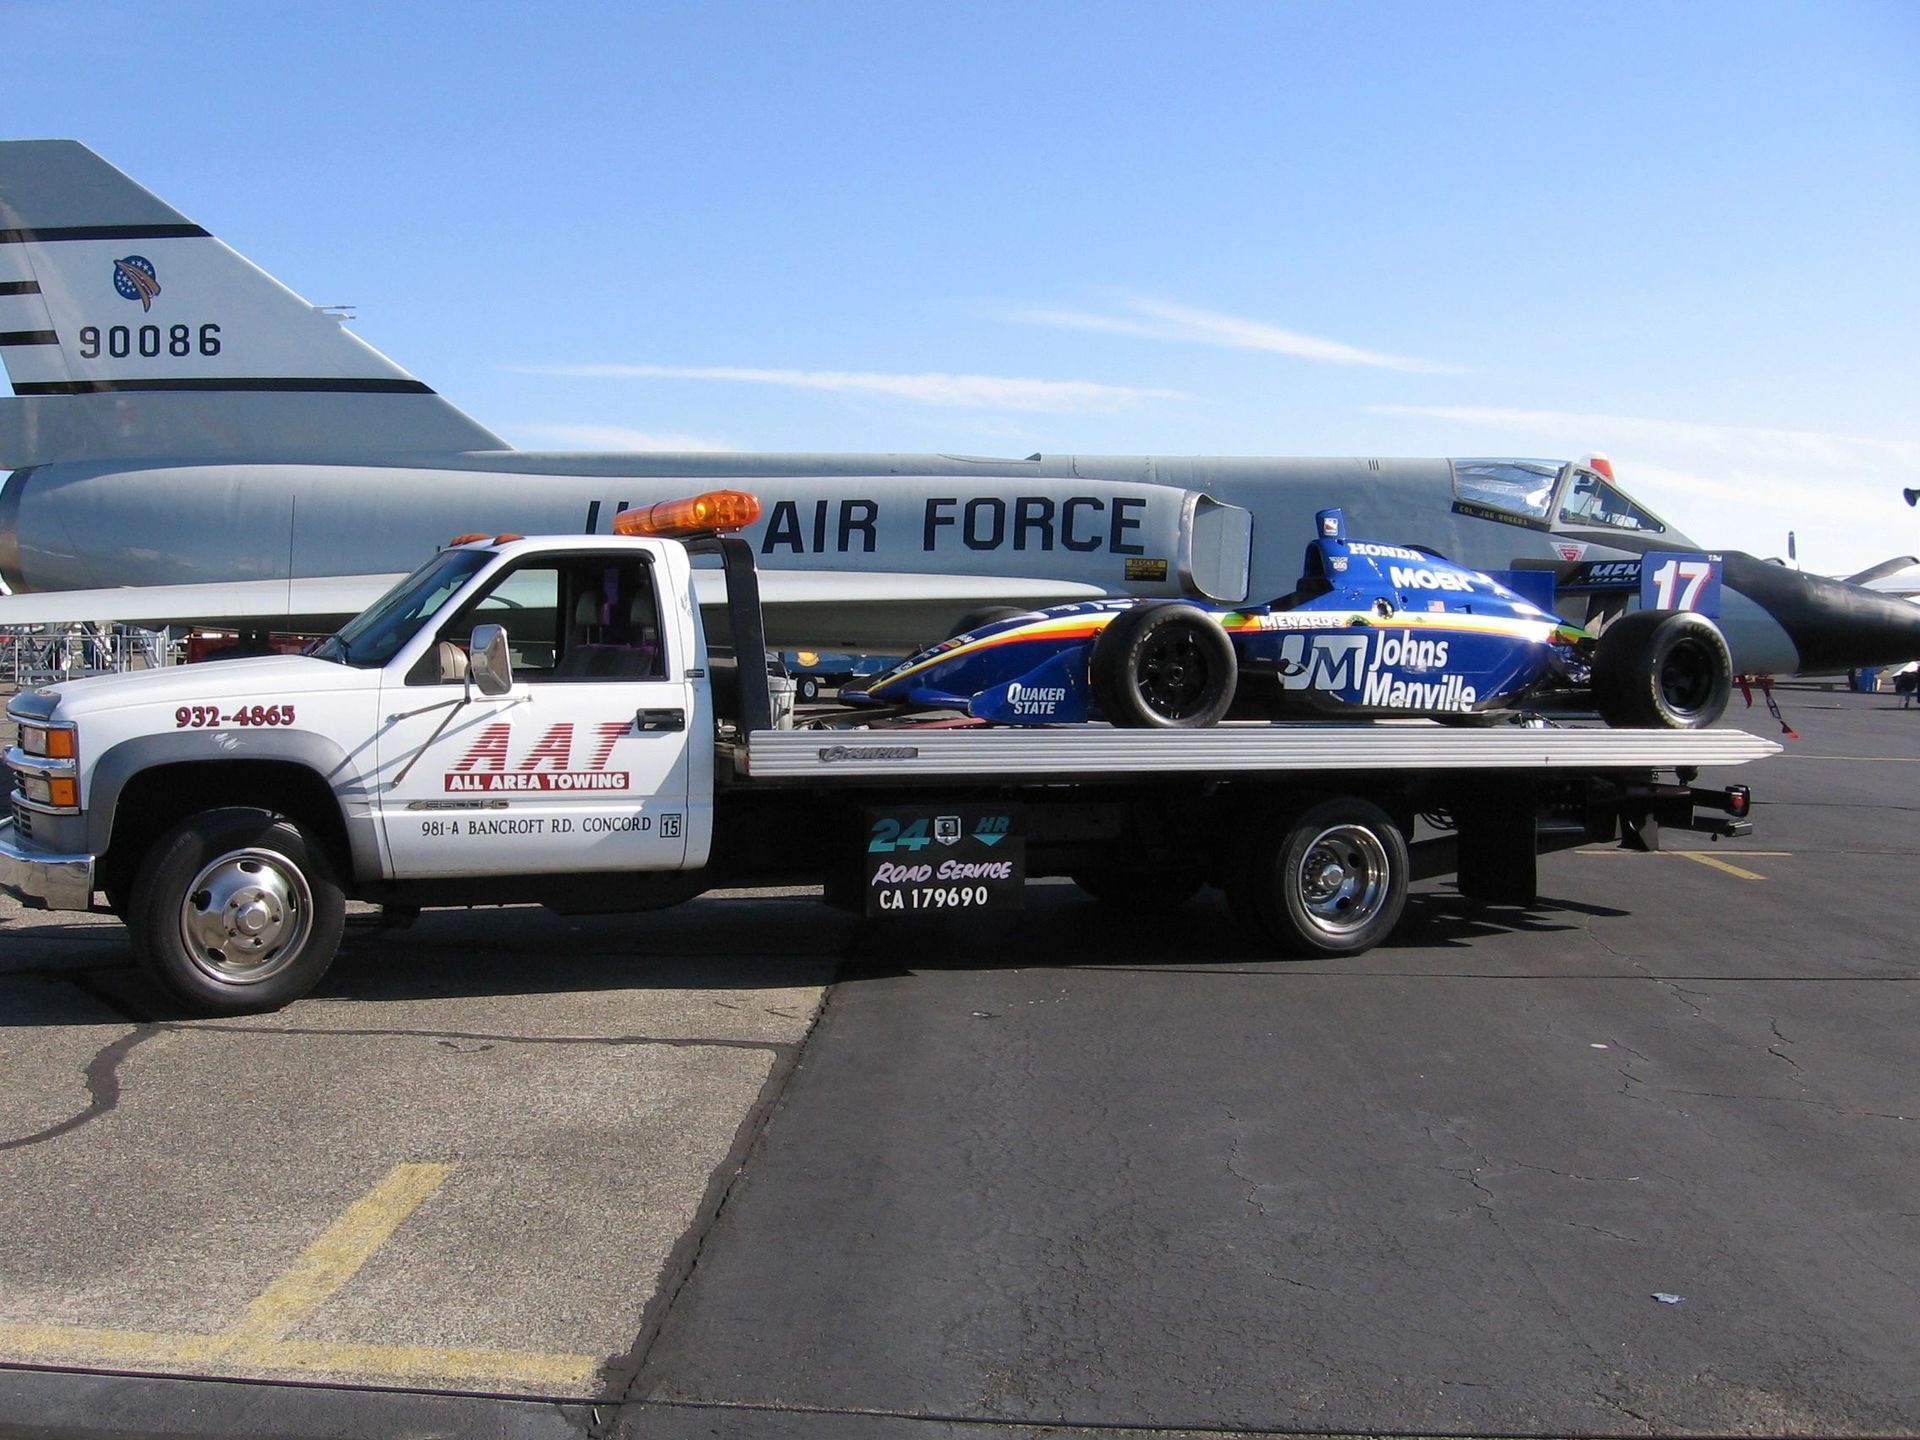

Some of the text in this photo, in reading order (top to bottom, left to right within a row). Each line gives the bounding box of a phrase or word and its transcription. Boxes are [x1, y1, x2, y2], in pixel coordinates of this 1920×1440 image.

[80, 324, 221, 358] 90086
[761, 497, 1147, 555] AIR FORCE
[1348, 543, 1426, 562] HONDA
[1389, 566, 1476, 592] MOEN
[1653, 560, 1712, 611] 17
[1258, 614, 1345, 630] MENARDS
[1369, 629, 1449, 671] Johns
[1007, 683, 1066, 705] QUAKER
[1362, 671, 1476, 712] Manville
[175, 705, 295, 728] 932-4865
[1014, 702, 1056, 715] STATE
[447, 722, 634, 771] AAT
[450, 773, 625, 791] ALL AREA TOWING
[421, 816, 651, 836] 981-A BANCROFT RD. CONCORD
[663, 820, 679, 836] 15
[868, 816, 1010, 852] 24 HR
[871, 859, 1013, 887] ROAD SERVICE
[879, 886, 988, 909] CA 179690
